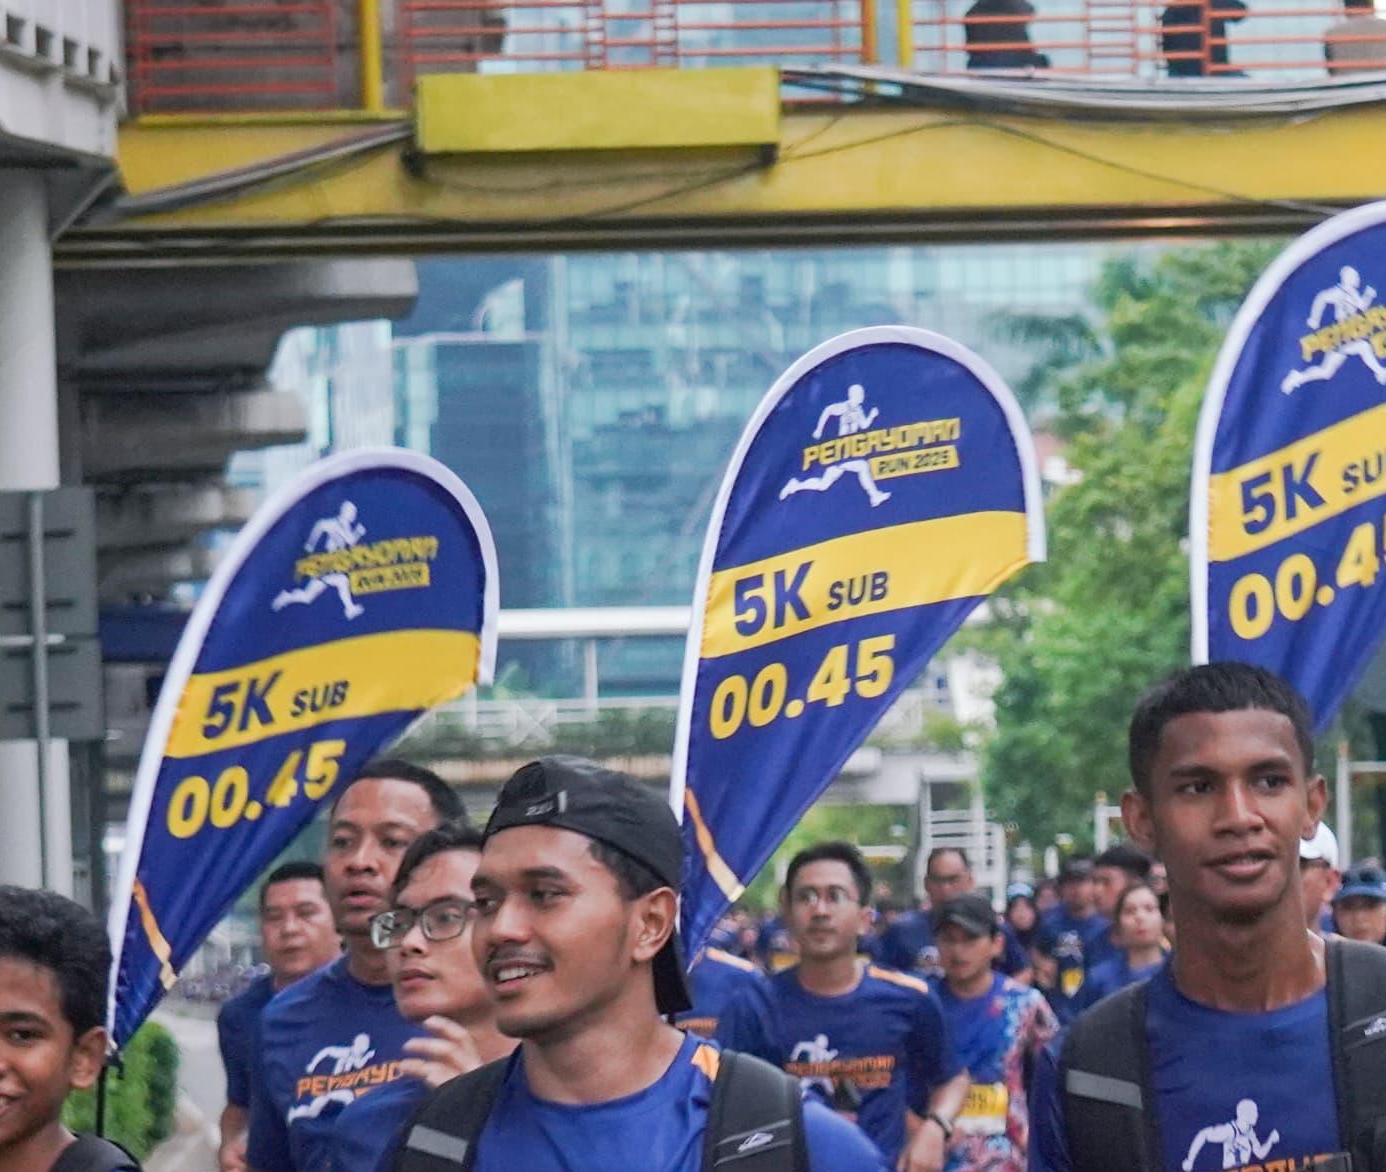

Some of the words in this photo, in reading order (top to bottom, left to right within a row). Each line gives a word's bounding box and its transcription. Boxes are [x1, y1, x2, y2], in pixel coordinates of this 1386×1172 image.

[802, 417, 961, 471] PENGAYOMAN
[877, 456, 909, 476] RUN
[1239, 451, 1328, 536] 5K
[733, 560, 816, 637] 5K
[826, 571, 890, 611] SUB
[201, 670, 282, 740] 5K
[290, 680, 350, 718] SUB
[709, 633, 897, 740] 00.45
[167, 739, 347, 839] 00.45
